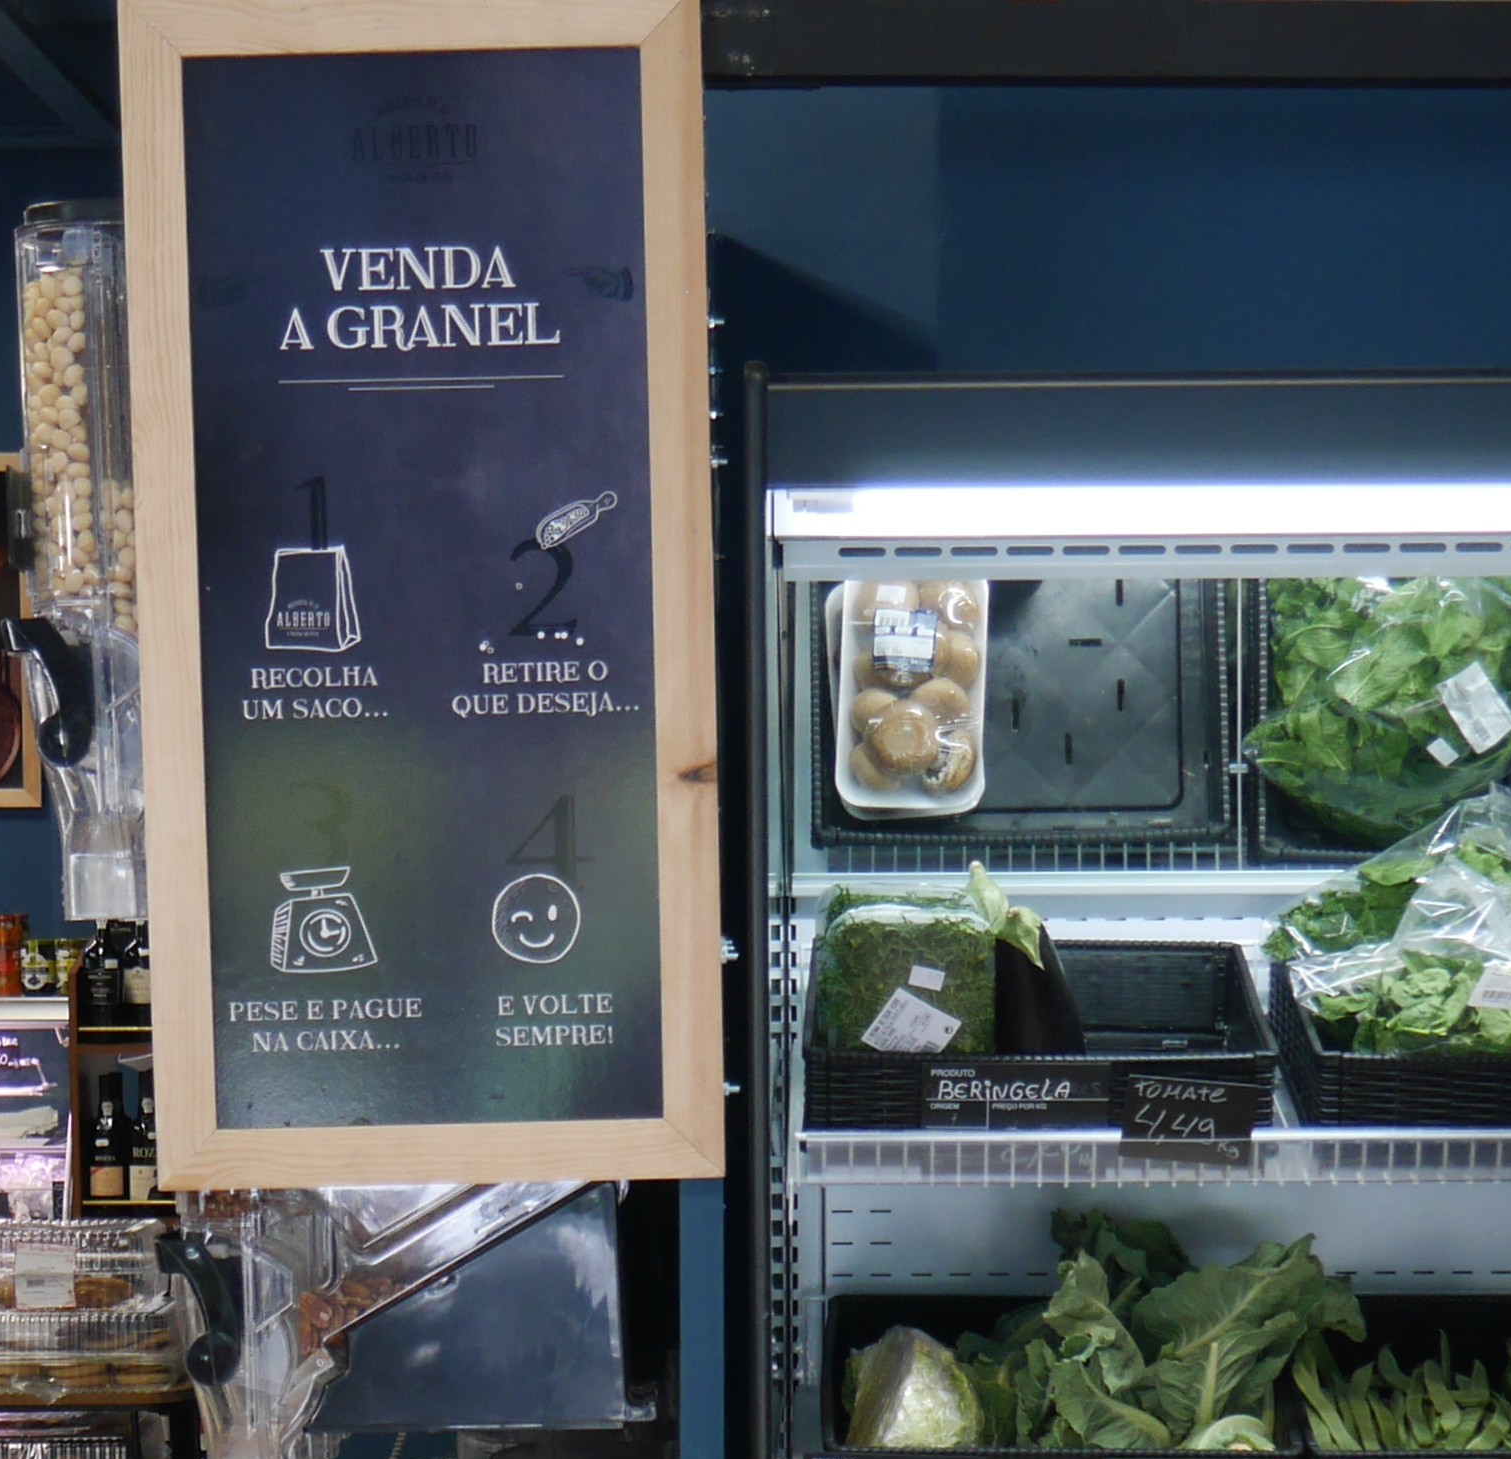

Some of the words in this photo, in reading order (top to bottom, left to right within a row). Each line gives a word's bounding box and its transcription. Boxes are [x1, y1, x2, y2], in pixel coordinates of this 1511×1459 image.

[320, 245, 515, 291] VENDA
[280, 308, 314, 350] A
[327, 302, 560, 352] GRANEL
[276, 611, 330, 627] ALBERTO
[251, 666, 378, 691] RECOLHA
[483, 662, 578, 686] RETIRE
[588, 660, 608, 681] O
[242, 699, 283, 720] UM
[292, 697, 389, 720] SACO...
[452, 694, 508, 718] QUE
[517, 691, 640, 717] DESEJA...
[229, 1000, 296, 1023] PESE
[306, 1000, 324, 1020] E
[332, 998, 423, 1021] PAGUE
[497, 996, 514, 1016] E
[523, 994, 613, 1016] VOLTE
[252, 1031, 289, 1053] NA
[297, 1029, 401, 1052] CAIXA...
[495, 1025, 614, 1048] SEMPRE!
[930, 1068, 976, 1078] PRODUTO
